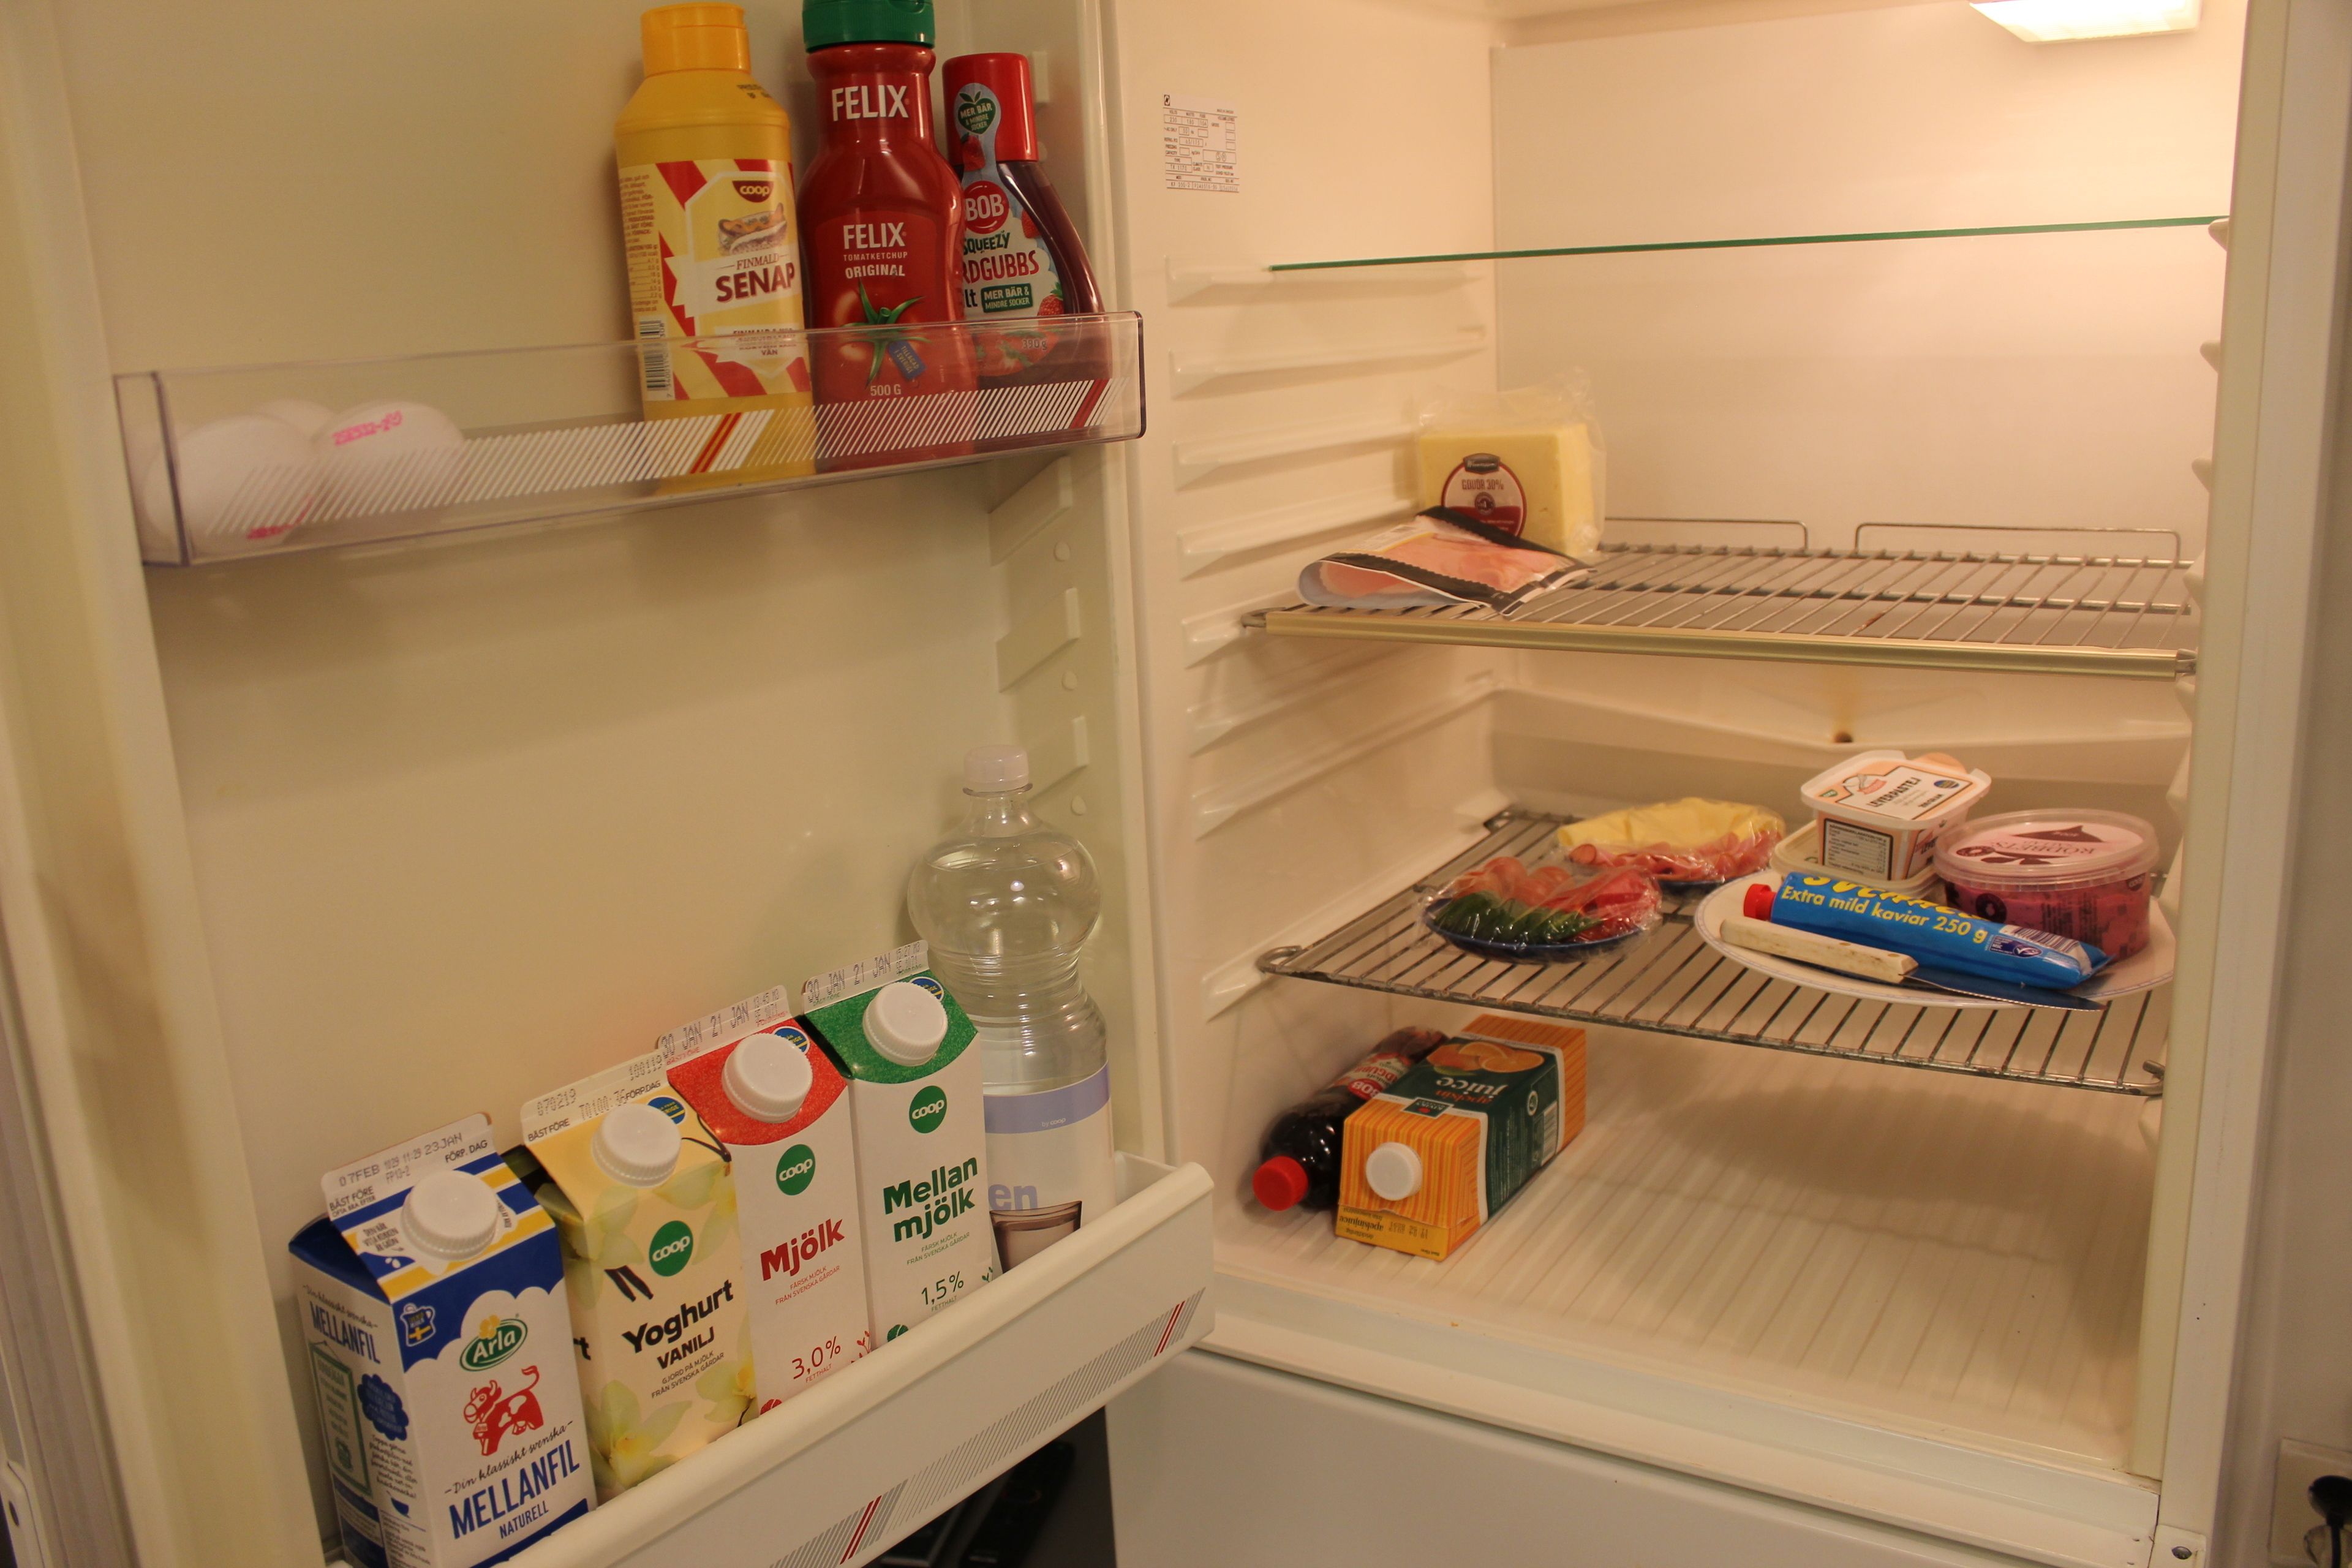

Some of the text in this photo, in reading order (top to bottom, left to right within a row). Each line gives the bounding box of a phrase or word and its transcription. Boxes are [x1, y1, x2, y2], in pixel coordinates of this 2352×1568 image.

[832, 85, 908, 121] FELIX
[960, 103, 992, 118] MER BÄR
[739, 186, 770, 197] coop
[965, 194, 1005, 221] BOB
[843, 222, 905, 249] FELIX
[736, 254, 779, 270] FINMALD
[843, 252, 908, 262] TOMATKETCHUP
[716, 262, 795, 303] SENAP
[845, 265, 905, 279] ORIGINAL
[984, 287, 1030, 300] MER BÄR &
[985, 297, 1030, 309] MINDRE SOCKER
[1023, 339, 1047, 350] 390 g
[870, 384, 901, 396] 500 G
[1487, 479, 1504, 490] 30%
[1866, 777, 1921, 807] LEVERPASTEJ
[1781, 886, 1988, 944] Extra mild kaviar 250 g
[827, 969, 845, 996] JAN
[853, 962, 865, 986] 21
[872, 952, 891, 978] JAN
[682, 1022, 703, 1050] JAN
[710, 1014, 723, 1038] 21
[730, 1001, 749, 1029] JAN
[1436, 1077, 1508, 1098] juice
[911, 1099, 945, 1120] coop
[528, 1127, 548, 1142] BÄST
[549, 1118, 570, 1132] FÖRE
[445, 1139, 488, 1163] FÖRP. DAG
[778, 1158, 813, 1182] coop
[330, 1186, 374, 1212] BÄST FÖRE
[883, 1157, 978, 1215] Mellan
[894, 1188, 975, 1243] mjölk
[1340, 1215, 1384, 1231] apelsinjuice
[652, 1235, 690, 1262] coop
[760, 1218, 845, 1281] Mjölk
[907, 1231, 970, 1265] FRÅN SVENSKA GÅRDAR
[921, 1231, 957, 1253] FÄRSK MJÖLK
[775, 1264, 840, 1305] FRÅN SVENSKA GÅRDAR
[790, 1265, 827, 1291] FÄRSK MJÖLK
[921, 1271, 964, 1306] 1,5%
[622, 1279, 733, 1354] Yoghurt
[931, 1295, 957, 1312] FETTHALT
[310, 1301, 381, 1365] MELLANFIL
[473, 1330, 516, 1363] Arla
[657, 1326, 714, 1370] VANILJ
[791, 1335, 841, 1380] 3,0%
[651, 1352, 725, 1398] FRÅN SVENSKA GÅRDAR
[662, 1351, 714, 1384] GJORD PÅ MJÖLK
[805, 1363, 832, 1383] FETTHALT
[478, 1445, 527, 1481] klassiskt
[528, 1426, 567, 1456] svenska
[449, 1439, 580, 1540] MELLANFIL
[499, 1501, 549, 1540] NATURELL
